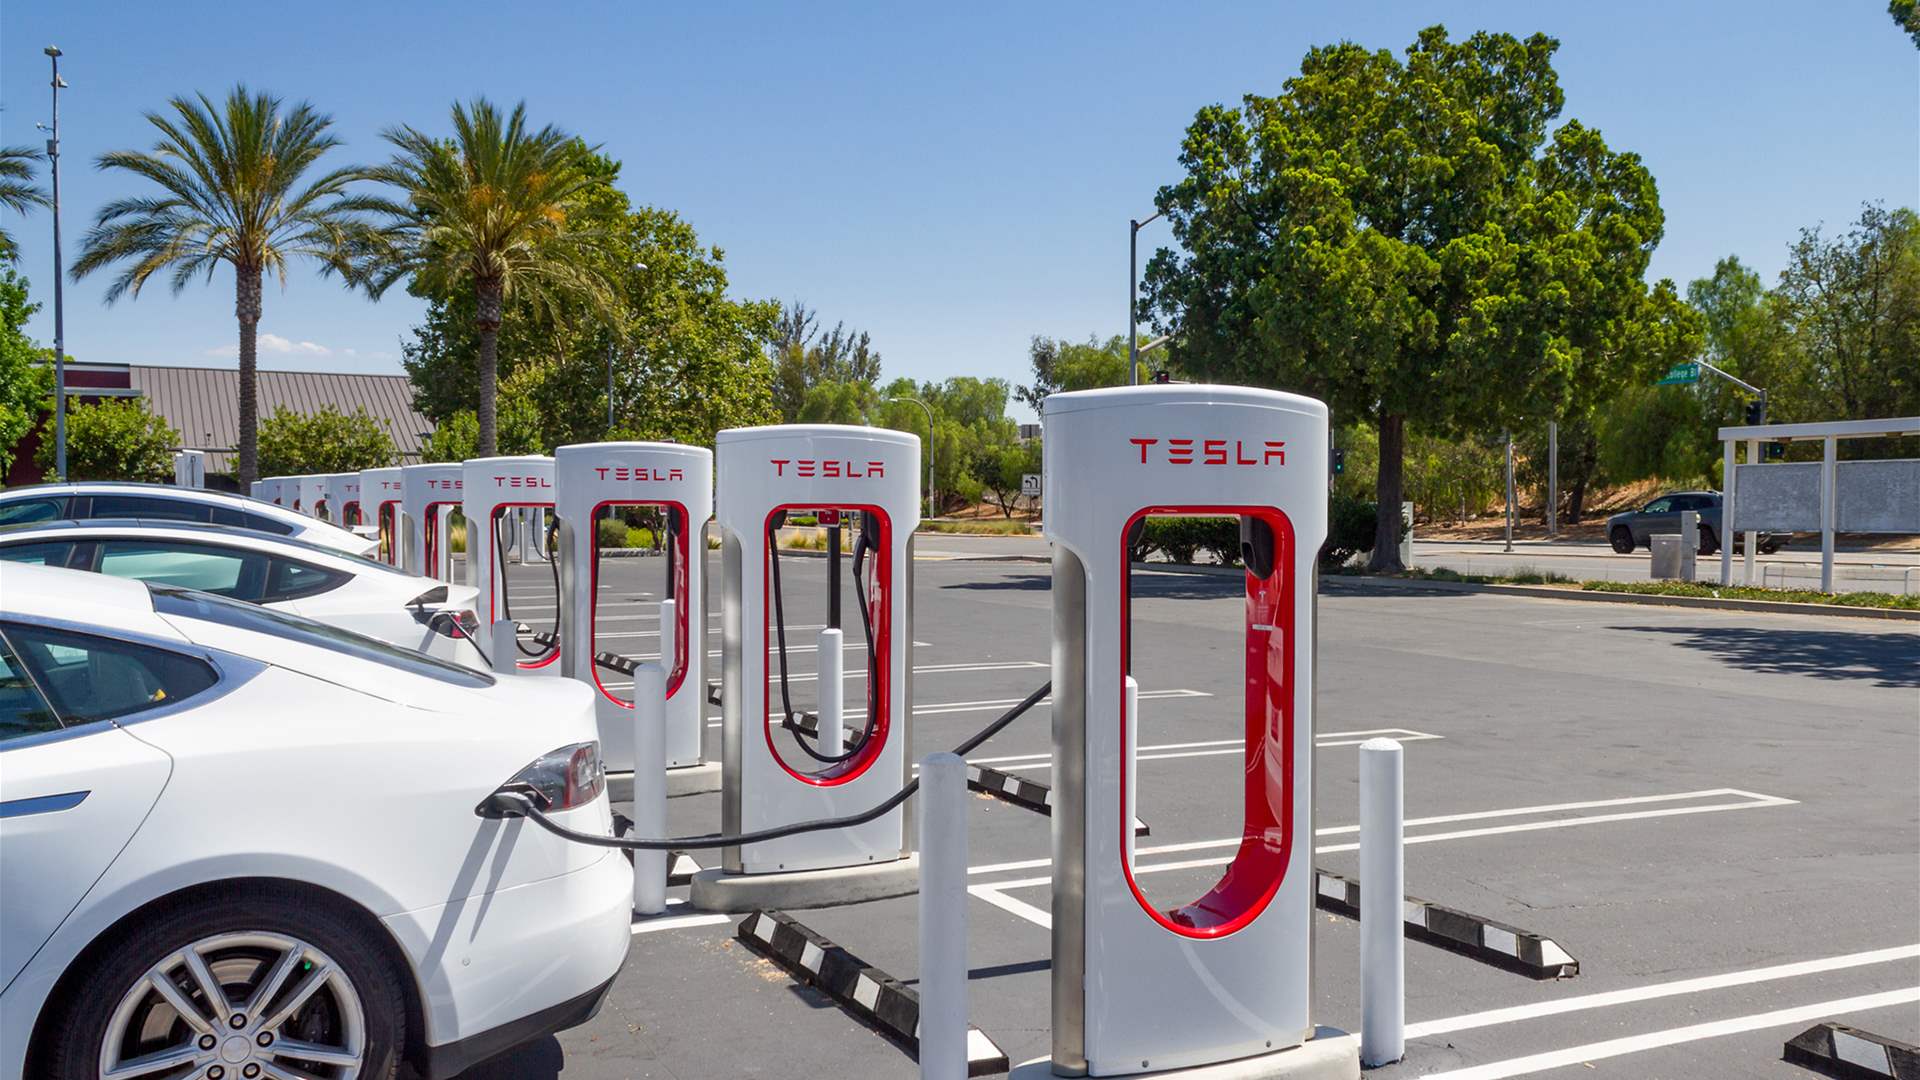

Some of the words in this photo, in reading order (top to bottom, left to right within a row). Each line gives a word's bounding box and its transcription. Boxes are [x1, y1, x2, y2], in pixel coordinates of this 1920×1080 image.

[1129, 437, 1286, 466] TESLA
[594, 467, 684, 482] TESLA
[770, 460, 885, 480] TESLA
[427, 479, 463, 490] TES
[494, 476, 552, 488] TESL
